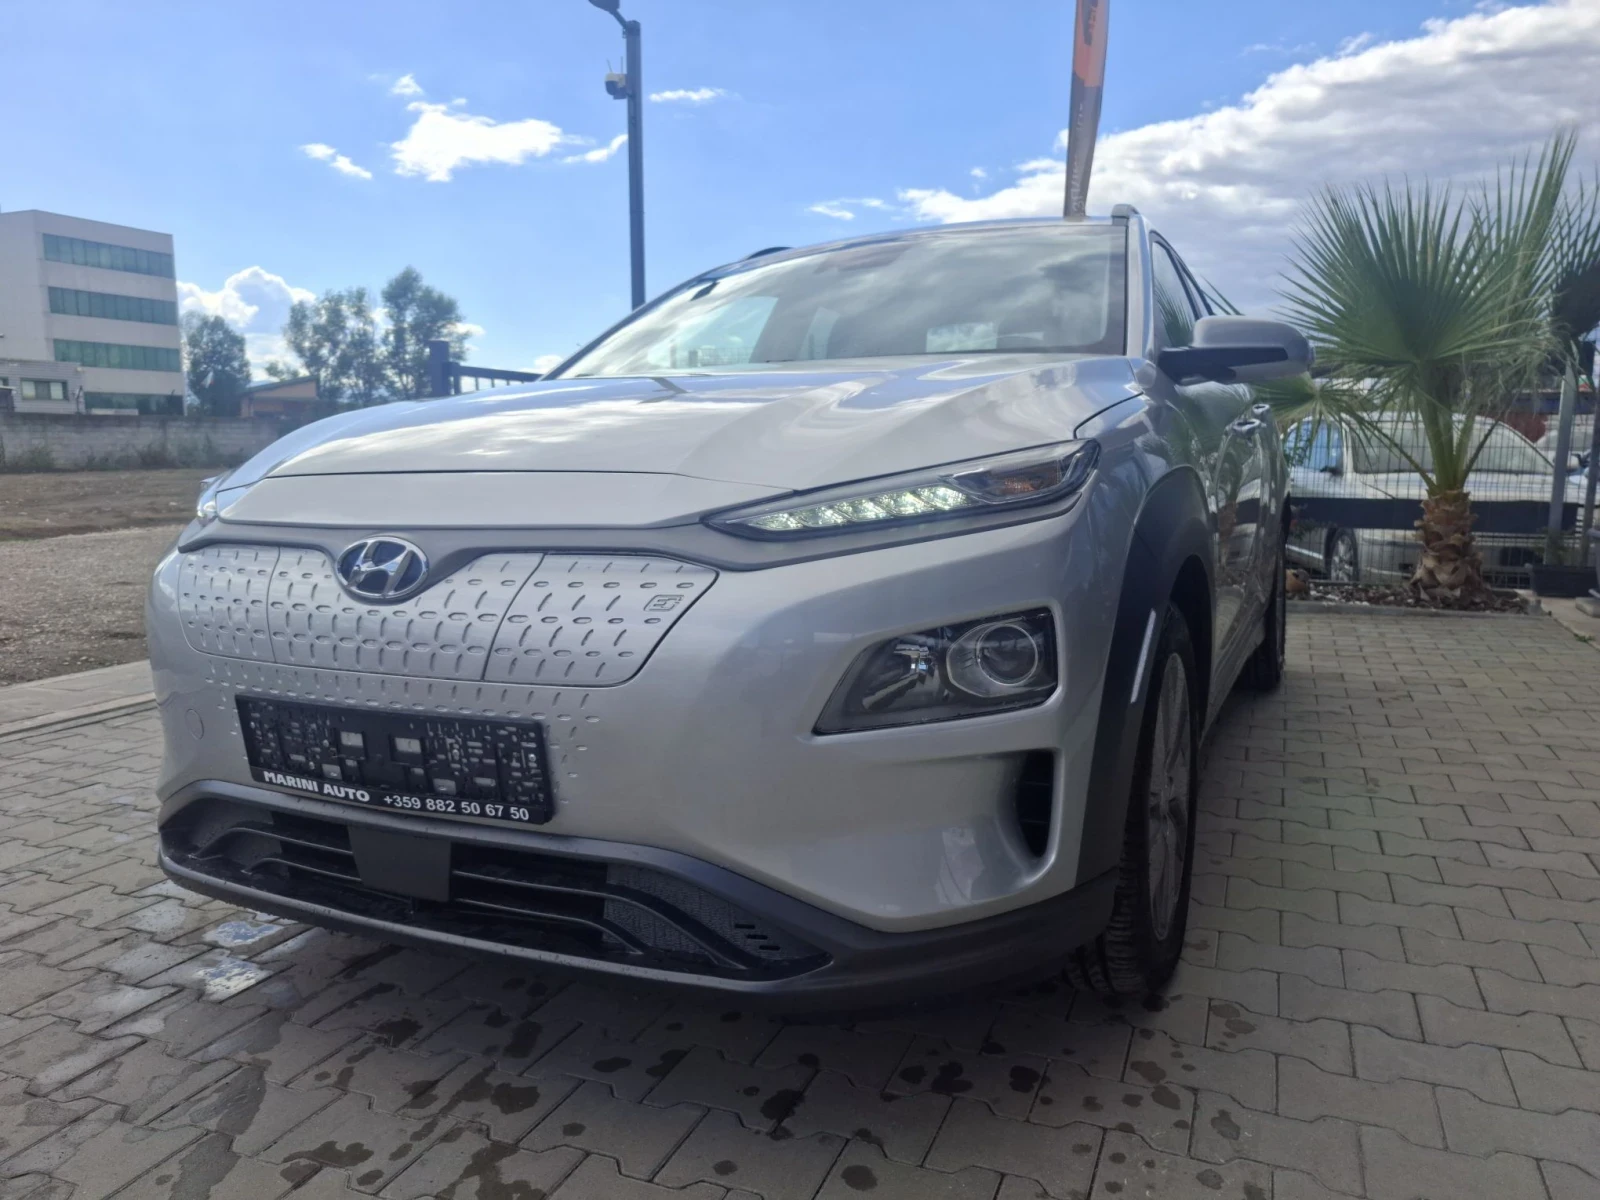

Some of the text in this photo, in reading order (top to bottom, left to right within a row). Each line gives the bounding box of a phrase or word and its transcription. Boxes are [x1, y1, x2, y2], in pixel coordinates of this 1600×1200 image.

[263, 770, 530, 821] MARINI AUTO +359 882 50 67 50
